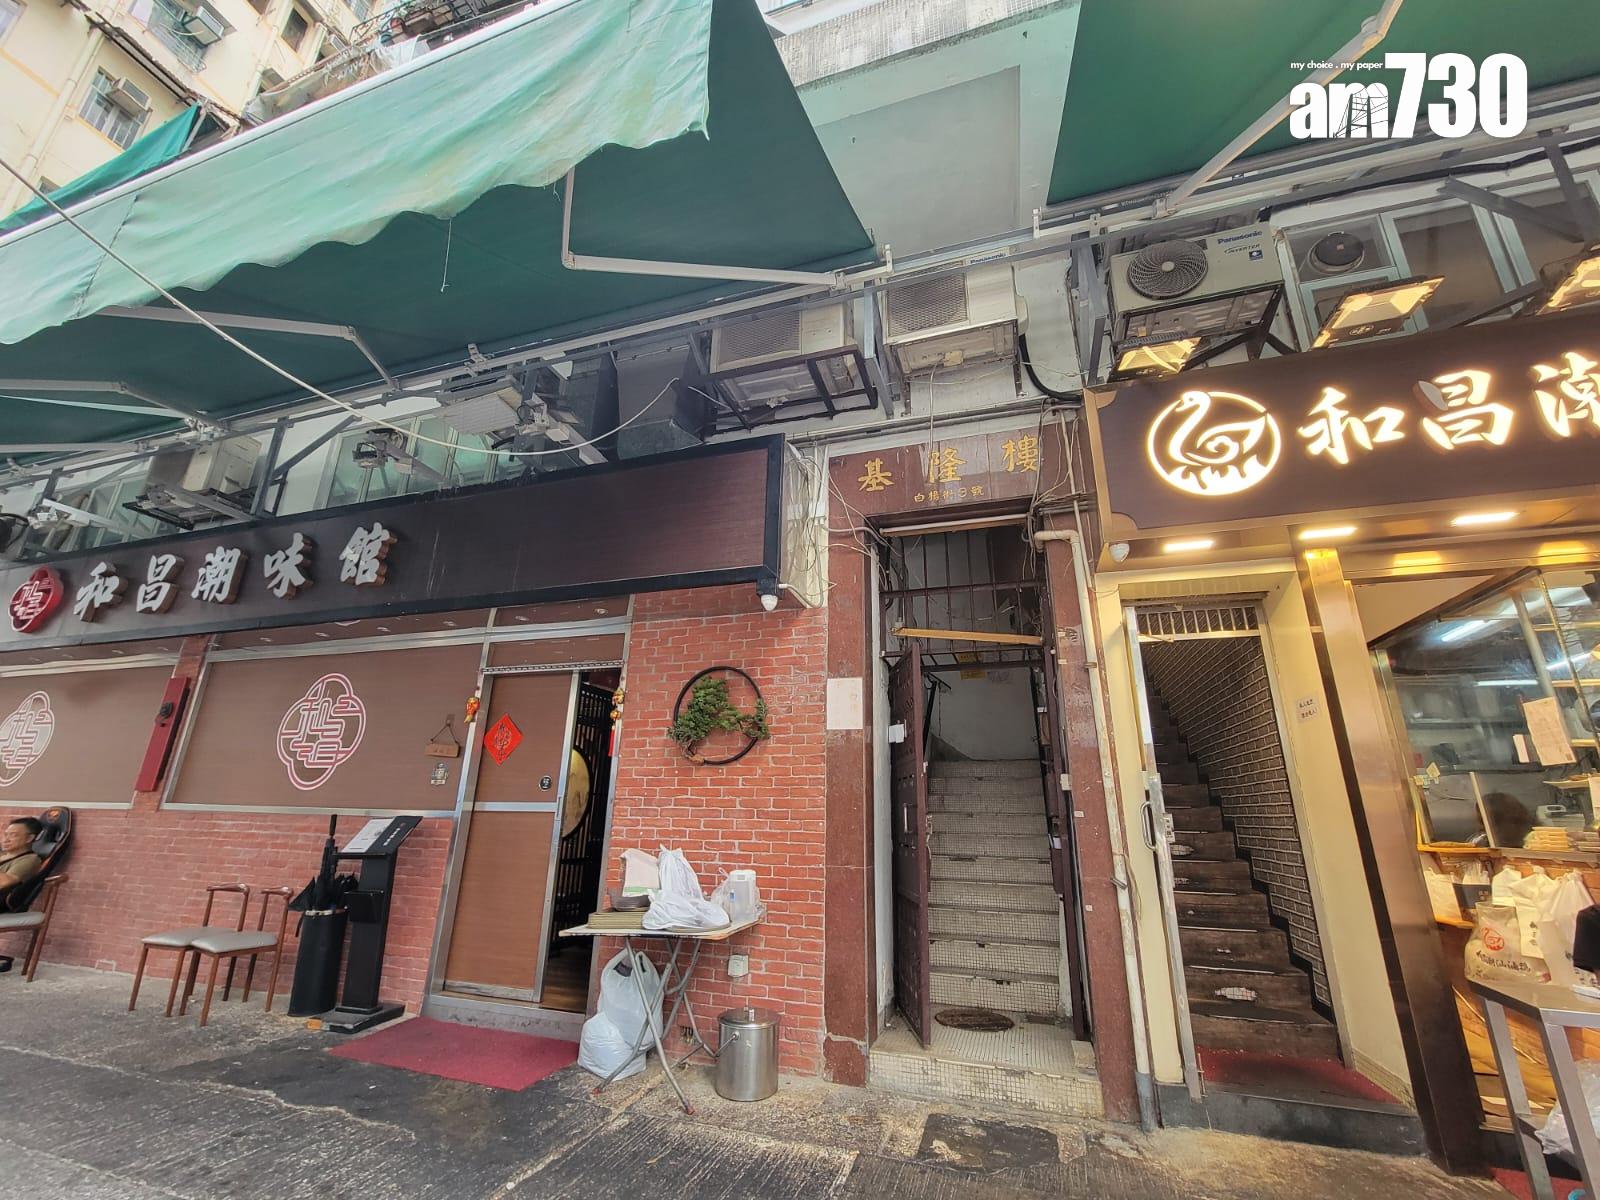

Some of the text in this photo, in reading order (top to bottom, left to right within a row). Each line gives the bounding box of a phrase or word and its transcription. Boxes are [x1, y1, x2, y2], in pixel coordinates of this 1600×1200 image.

[1217, 230, 1263, 244] Panasonic
[858, 434, 1039, 492] 基隆樓
[74, 521, 396, 621] 和昌潮味館
